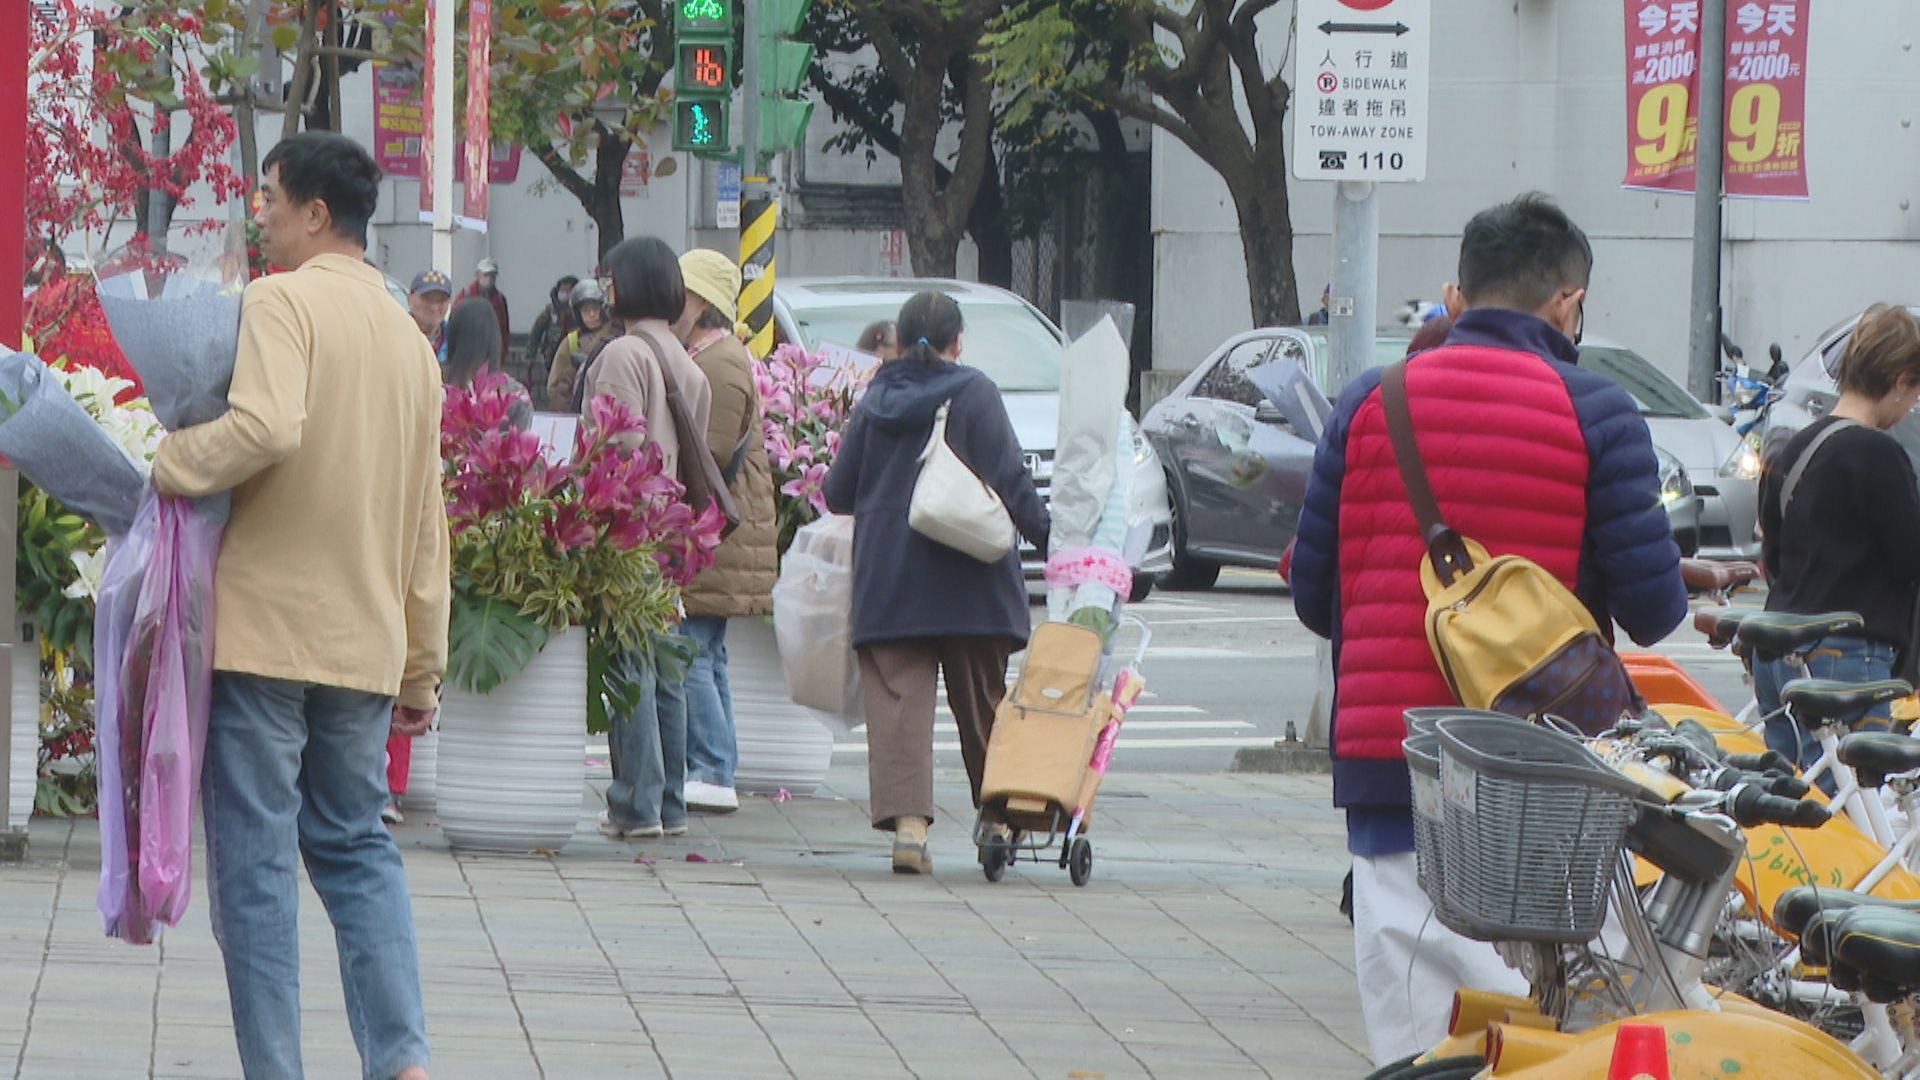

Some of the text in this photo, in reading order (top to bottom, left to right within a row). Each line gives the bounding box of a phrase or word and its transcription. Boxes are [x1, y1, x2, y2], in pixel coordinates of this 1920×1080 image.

[1638, 2, 1698, 36] 今天
[1736, 3, 1797, 37] 今天
[695, 48, 723, 86] 16
[1319, 49, 1408, 69] 人行道
[1342, 77, 1407, 91] SIDEWALK
[1318, 99, 1407, 117] 違者拖吊
[1310, 125, 1414, 139] TOW-AWAY ZONE
[1358, 151, 1404, 170] 110
